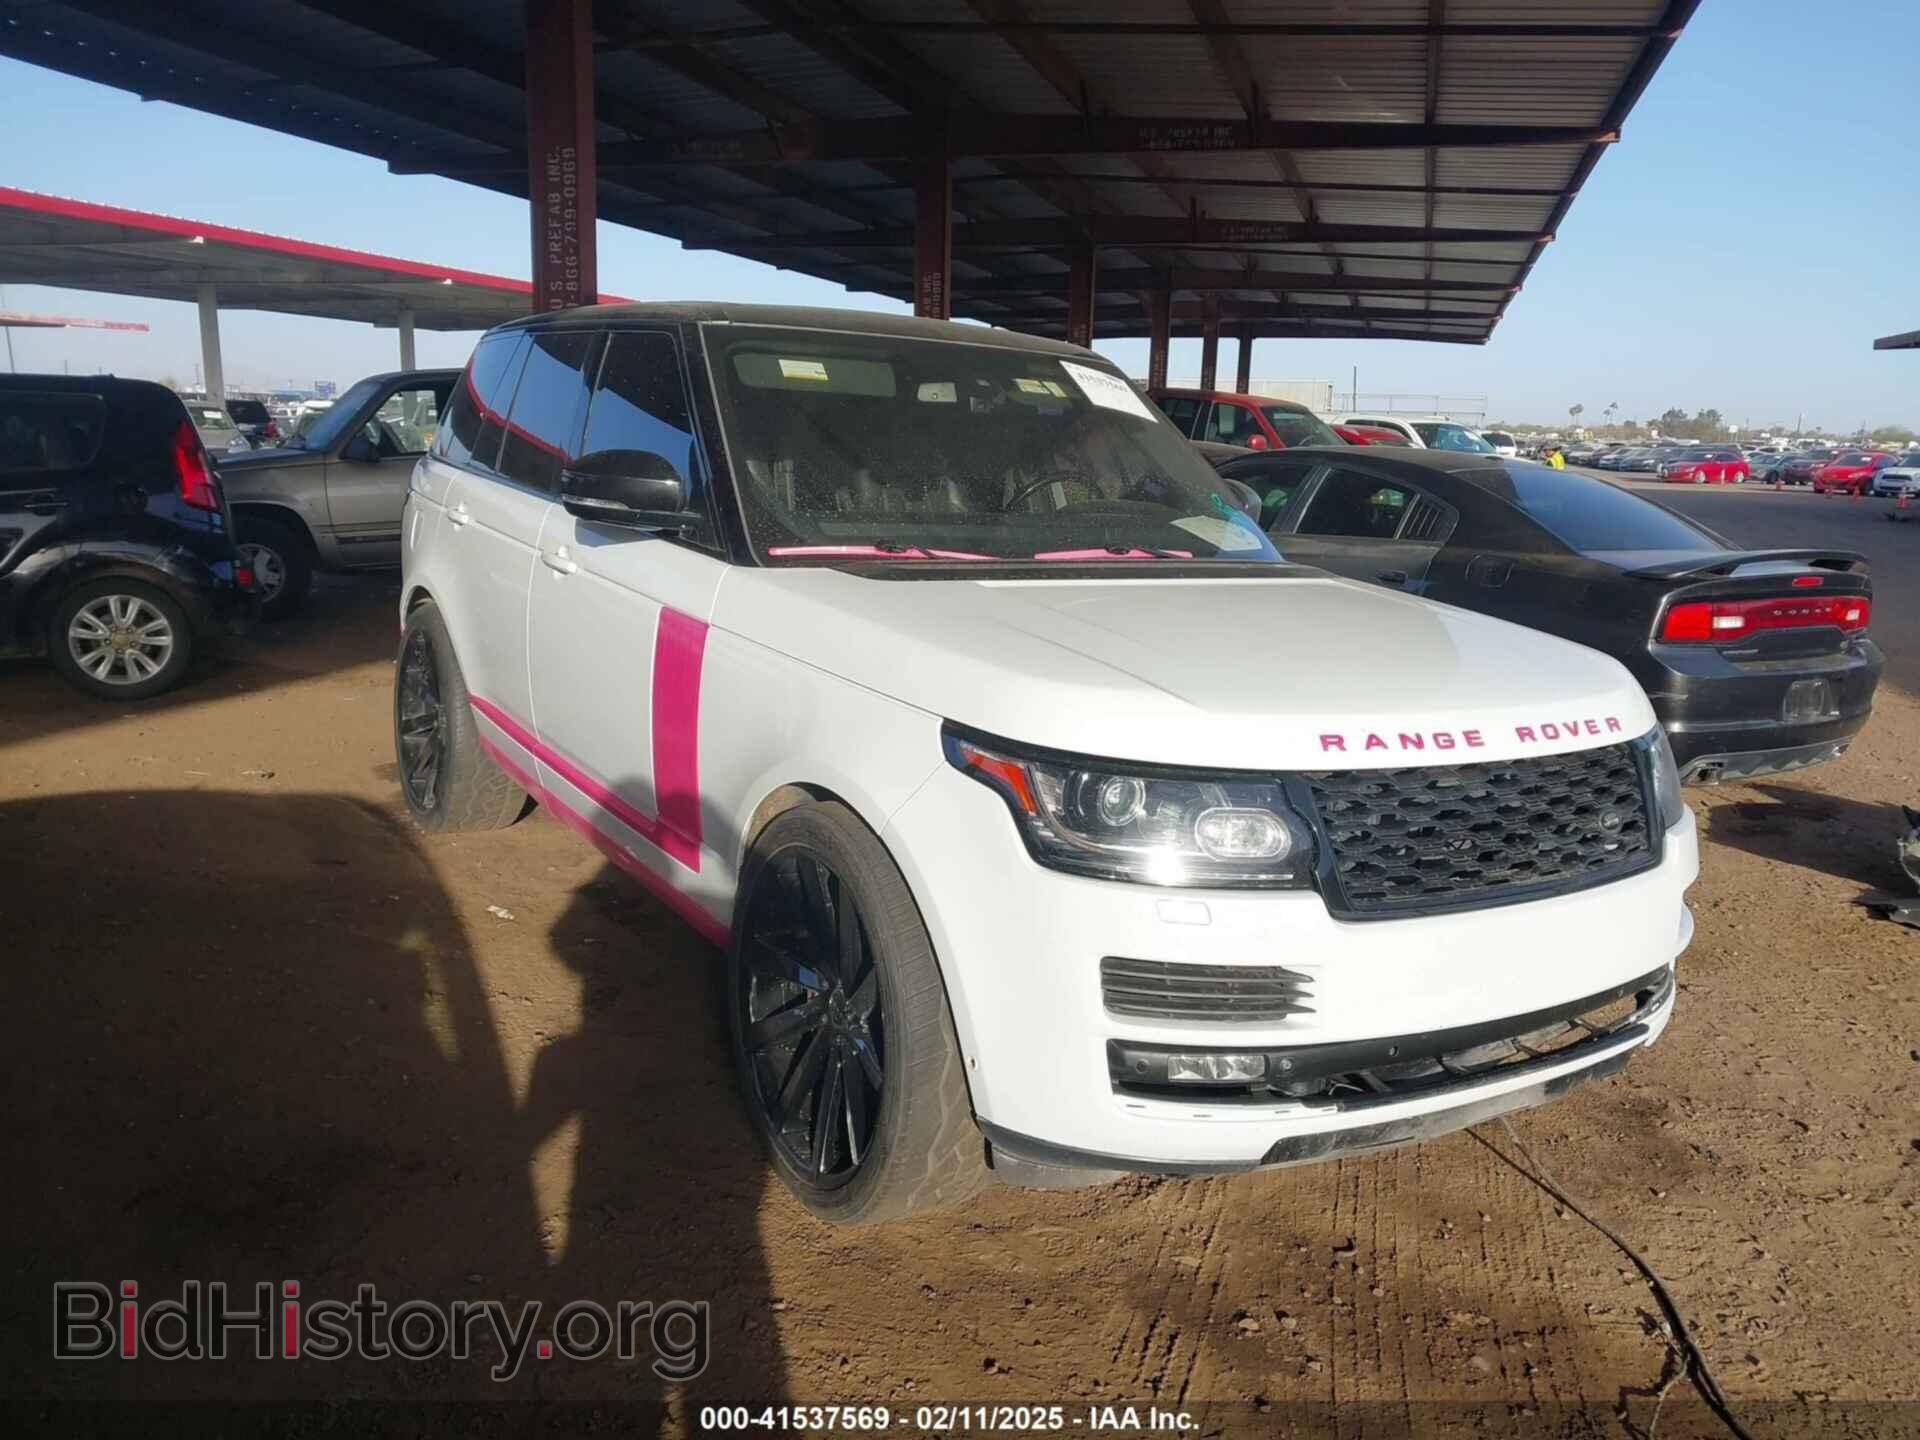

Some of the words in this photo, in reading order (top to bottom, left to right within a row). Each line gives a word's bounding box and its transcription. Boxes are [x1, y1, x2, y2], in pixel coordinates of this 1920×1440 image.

[548, 192, 562, 264] PREFAB
[1319, 729, 1485, 752] RANGE
[1514, 716, 1623, 743] ROVER
